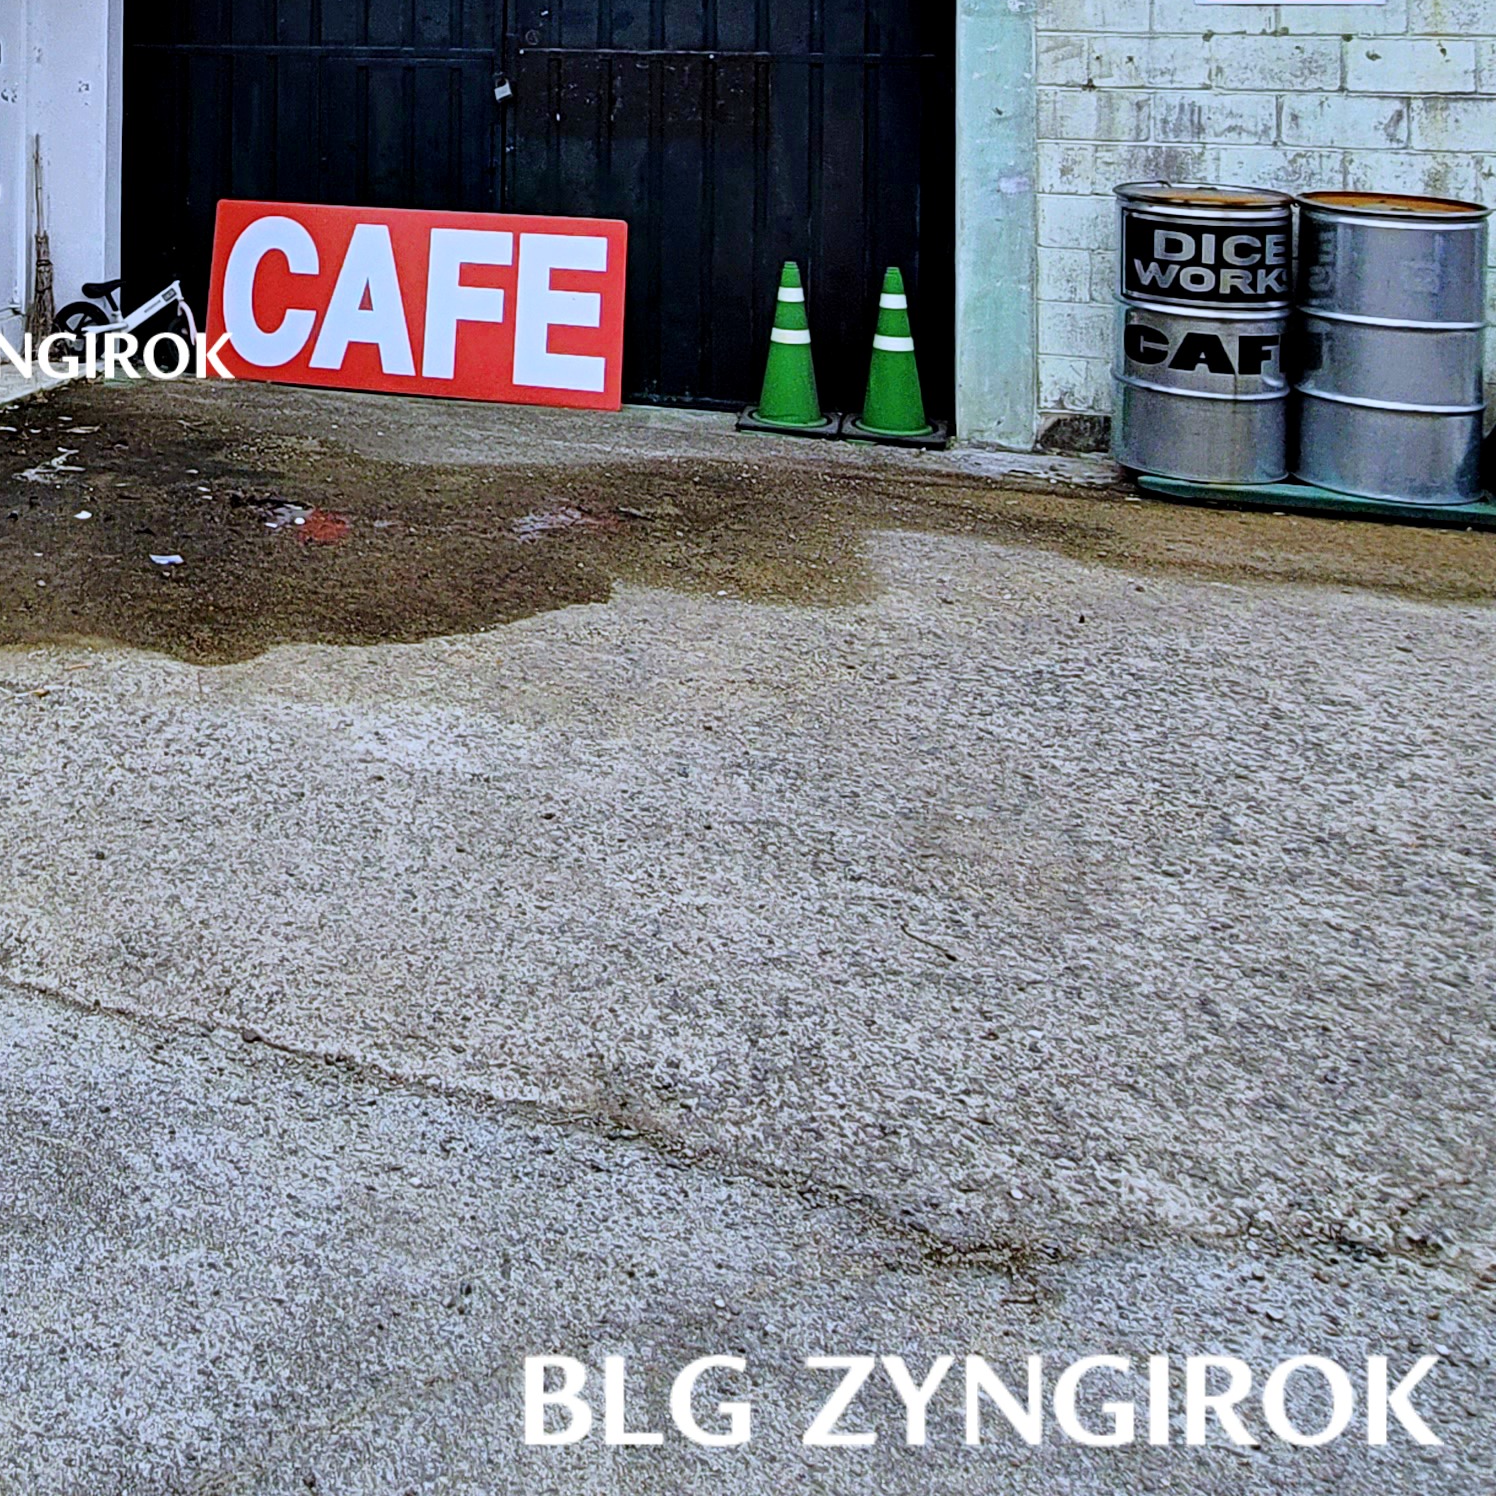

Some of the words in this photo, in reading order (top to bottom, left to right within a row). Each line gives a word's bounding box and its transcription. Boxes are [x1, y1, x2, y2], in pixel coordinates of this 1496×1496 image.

[1134, 257, 1288, 295] WORK
[223, 215, 608, 393] CAFE
[1124, 324, 1286, 376] CAF
